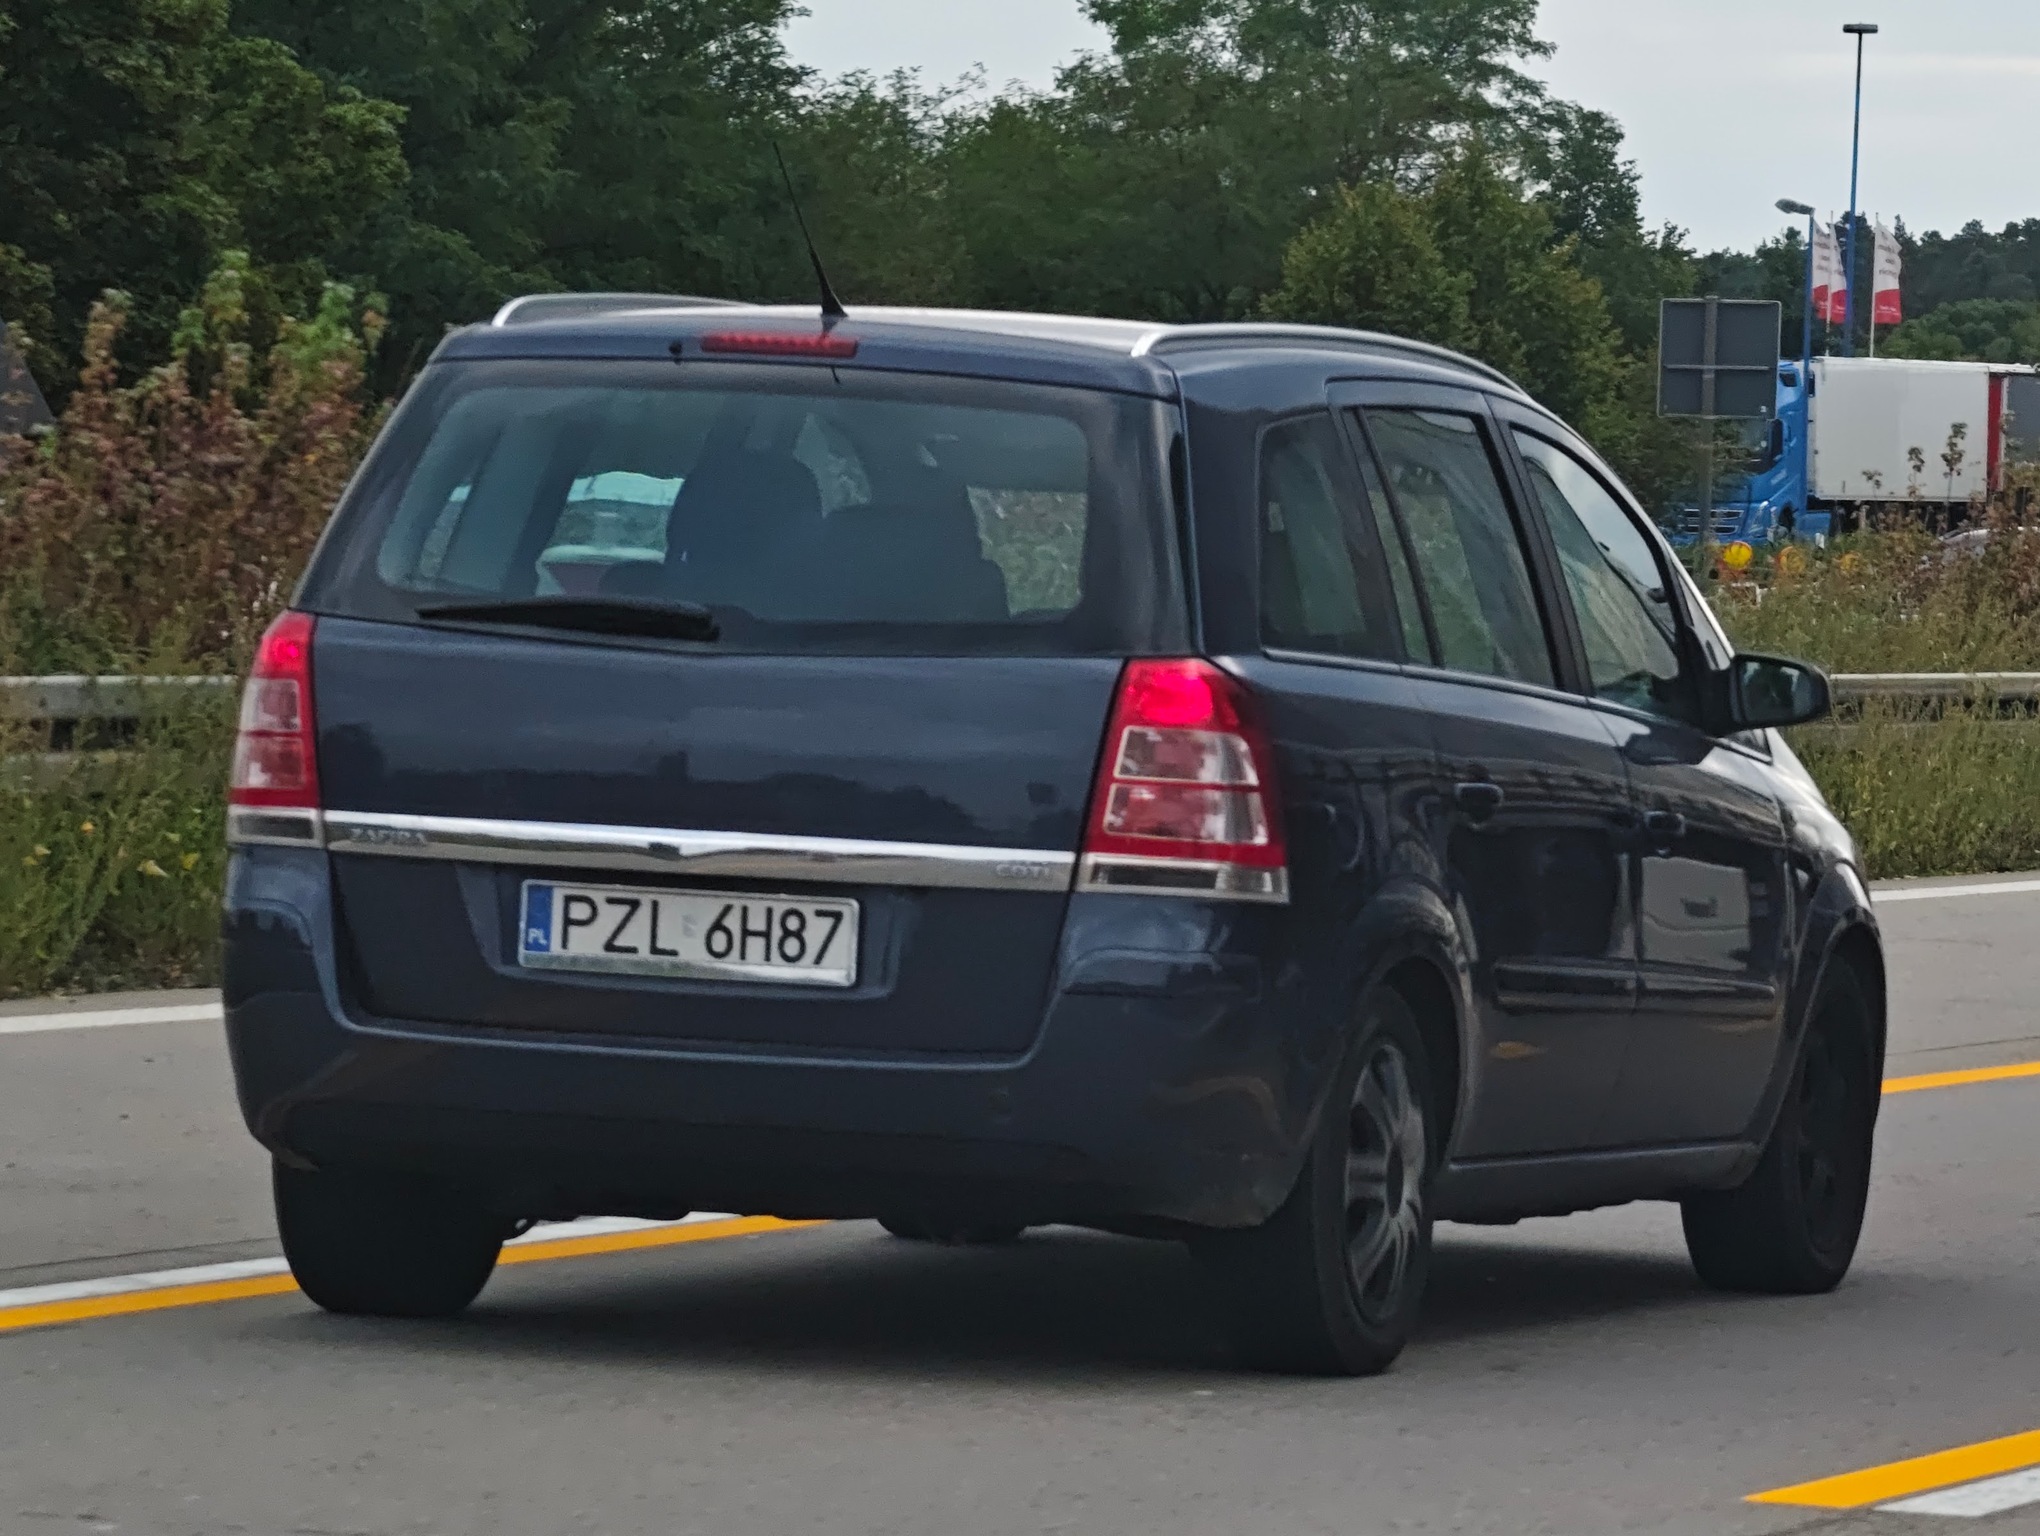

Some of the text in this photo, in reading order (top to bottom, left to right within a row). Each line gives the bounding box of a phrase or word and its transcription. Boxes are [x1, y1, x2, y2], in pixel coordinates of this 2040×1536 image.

[527, 928, 548, 946] PL
[561, 894, 844, 965] PZL 6H87
